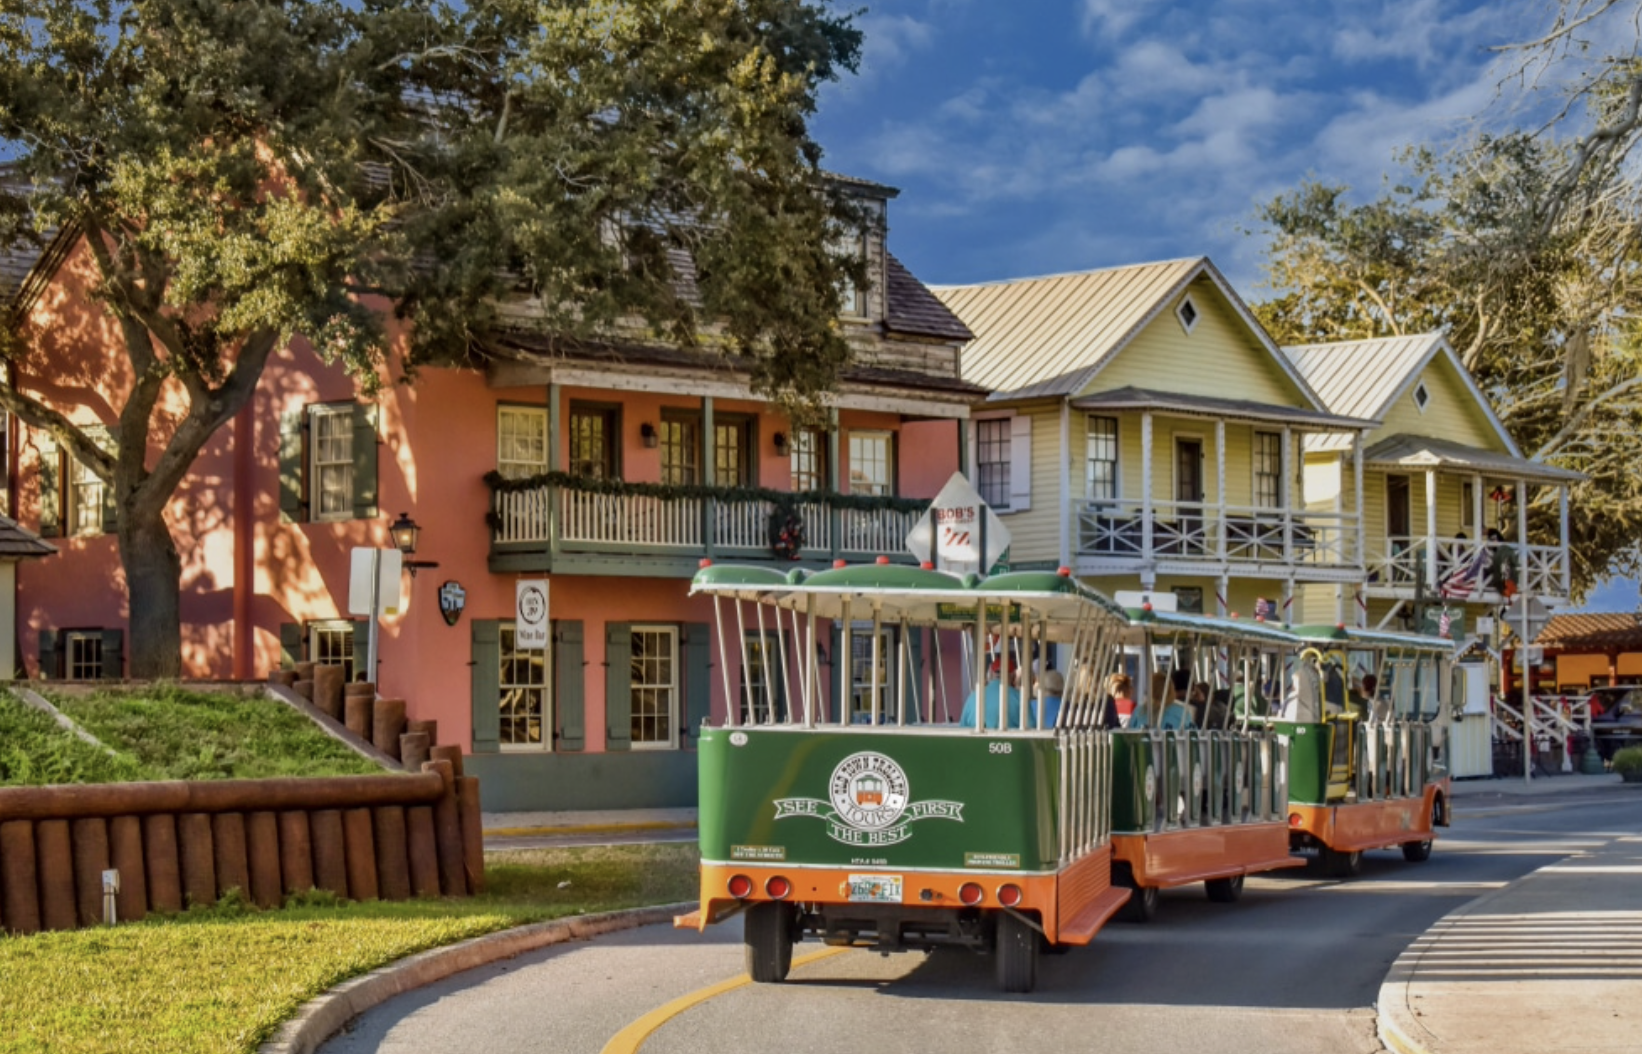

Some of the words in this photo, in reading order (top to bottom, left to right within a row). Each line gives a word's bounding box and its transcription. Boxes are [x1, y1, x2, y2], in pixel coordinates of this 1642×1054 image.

[937, 506, 975, 520] BOB'S
[989, 742, 1012, 754] 50B
[841, 756, 869, 777] TOWN
[834, 775, 849, 795] OLD
[873, 757, 904, 797] TROLLEY
[784, 801, 818, 814] SEE
[846, 802, 897, 825] TOURS
[912, 803, 958, 817] FIRST
[831, 823, 863, 843] THE
[868, 824, 908, 844] BEST
